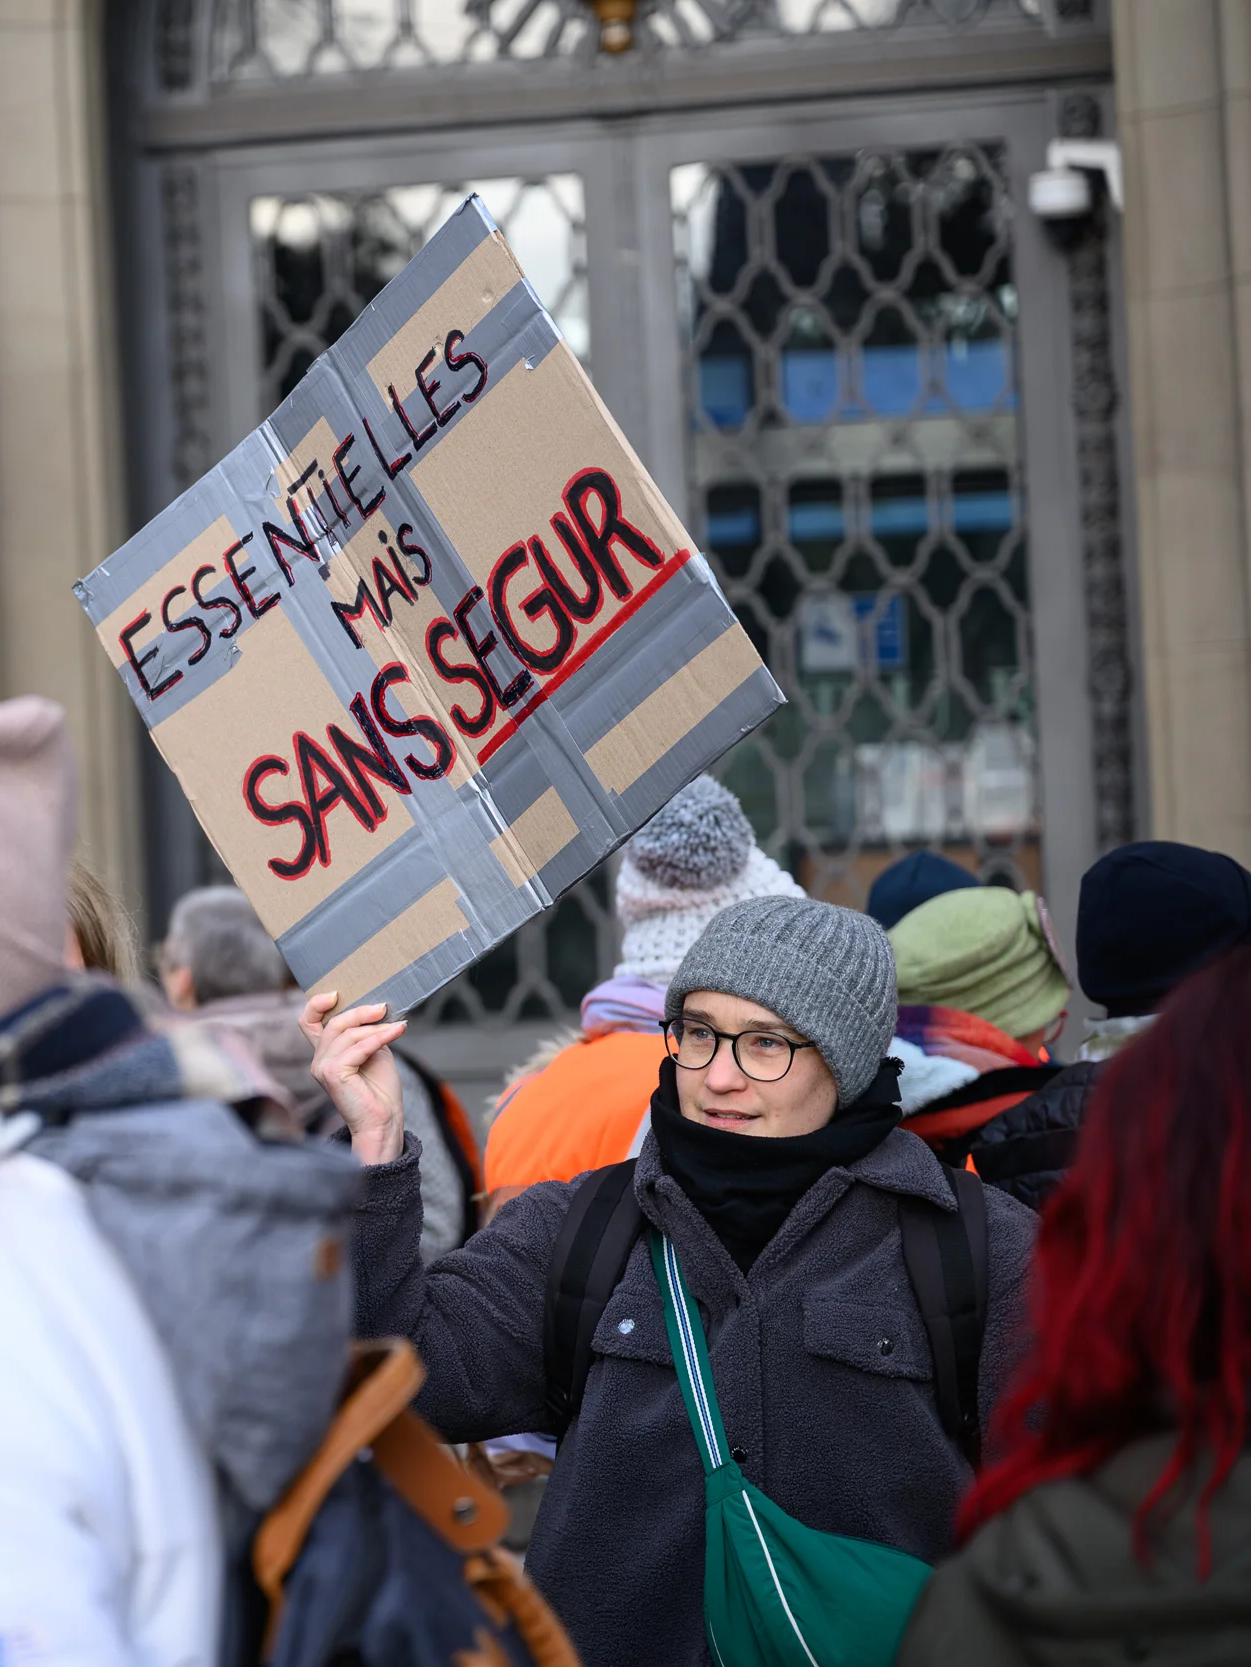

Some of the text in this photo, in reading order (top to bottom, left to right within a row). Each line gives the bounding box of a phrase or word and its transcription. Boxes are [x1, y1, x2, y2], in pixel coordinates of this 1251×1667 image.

[119, 329, 488, 700] ESSENTIELLES
[243, 466, 665, 880] SANS SEGUR
